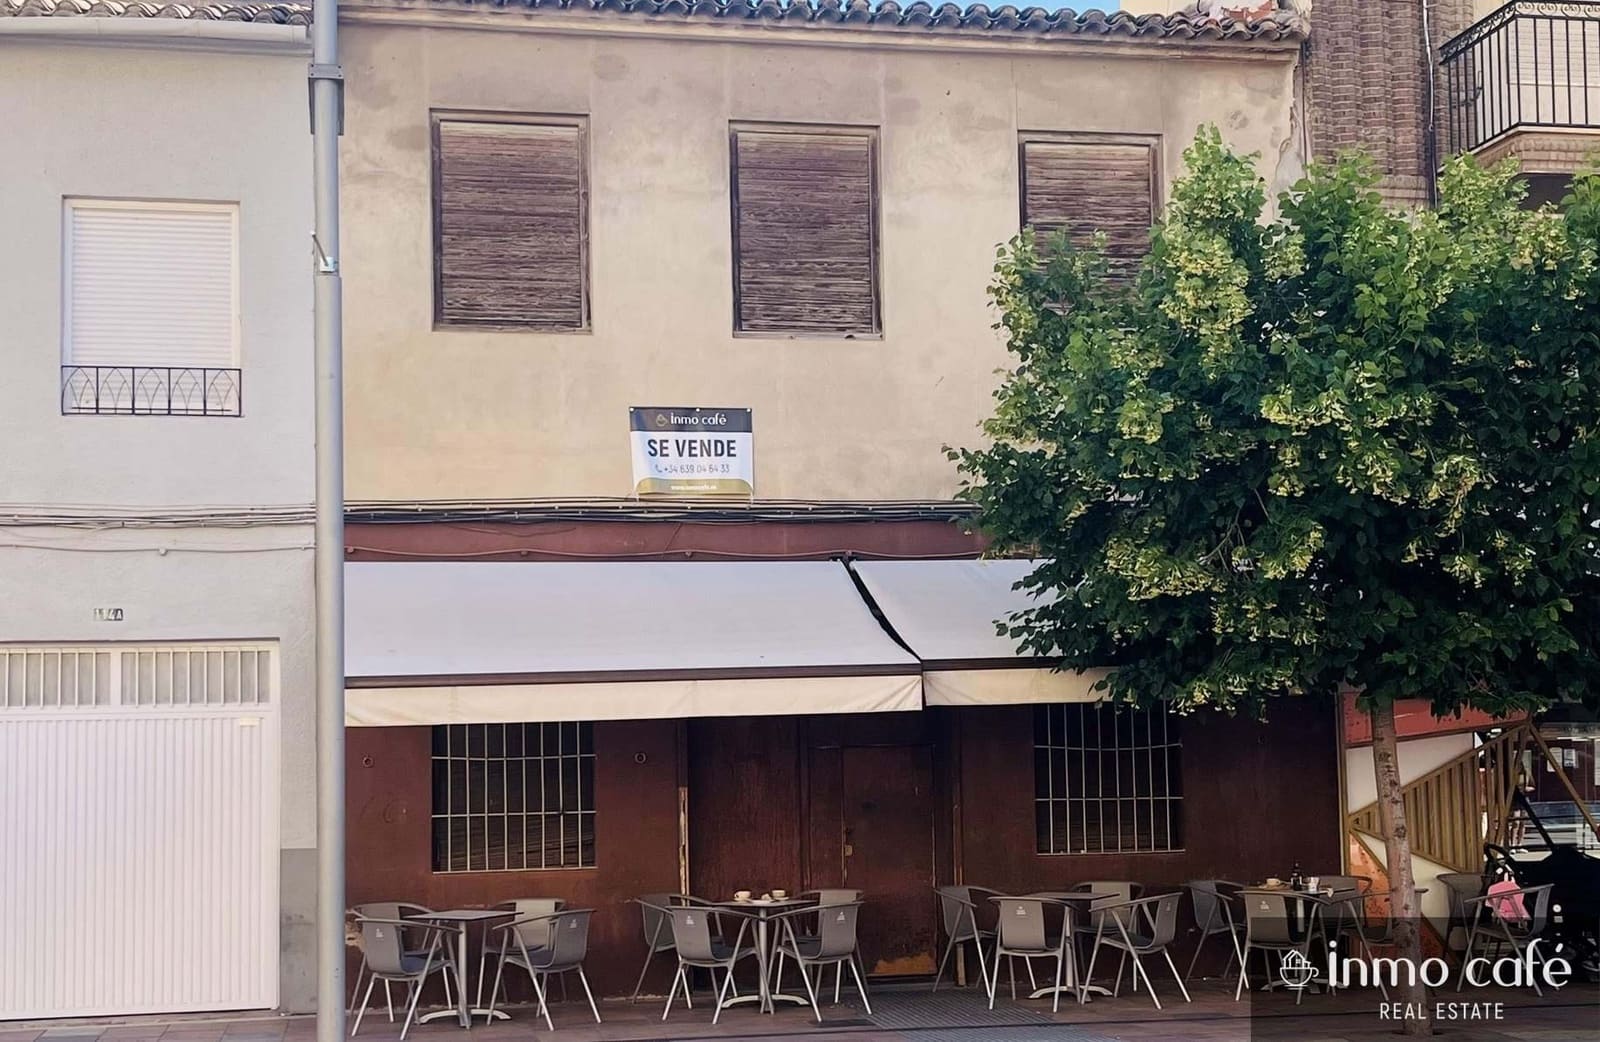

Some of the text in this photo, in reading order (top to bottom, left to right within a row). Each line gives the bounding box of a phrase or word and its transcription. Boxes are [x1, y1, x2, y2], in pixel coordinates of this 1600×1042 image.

[671, 413, 727, 425] inmo café
[648, 439, 736, 457] SE VENDE
[721, 464, 730, 473] 33
